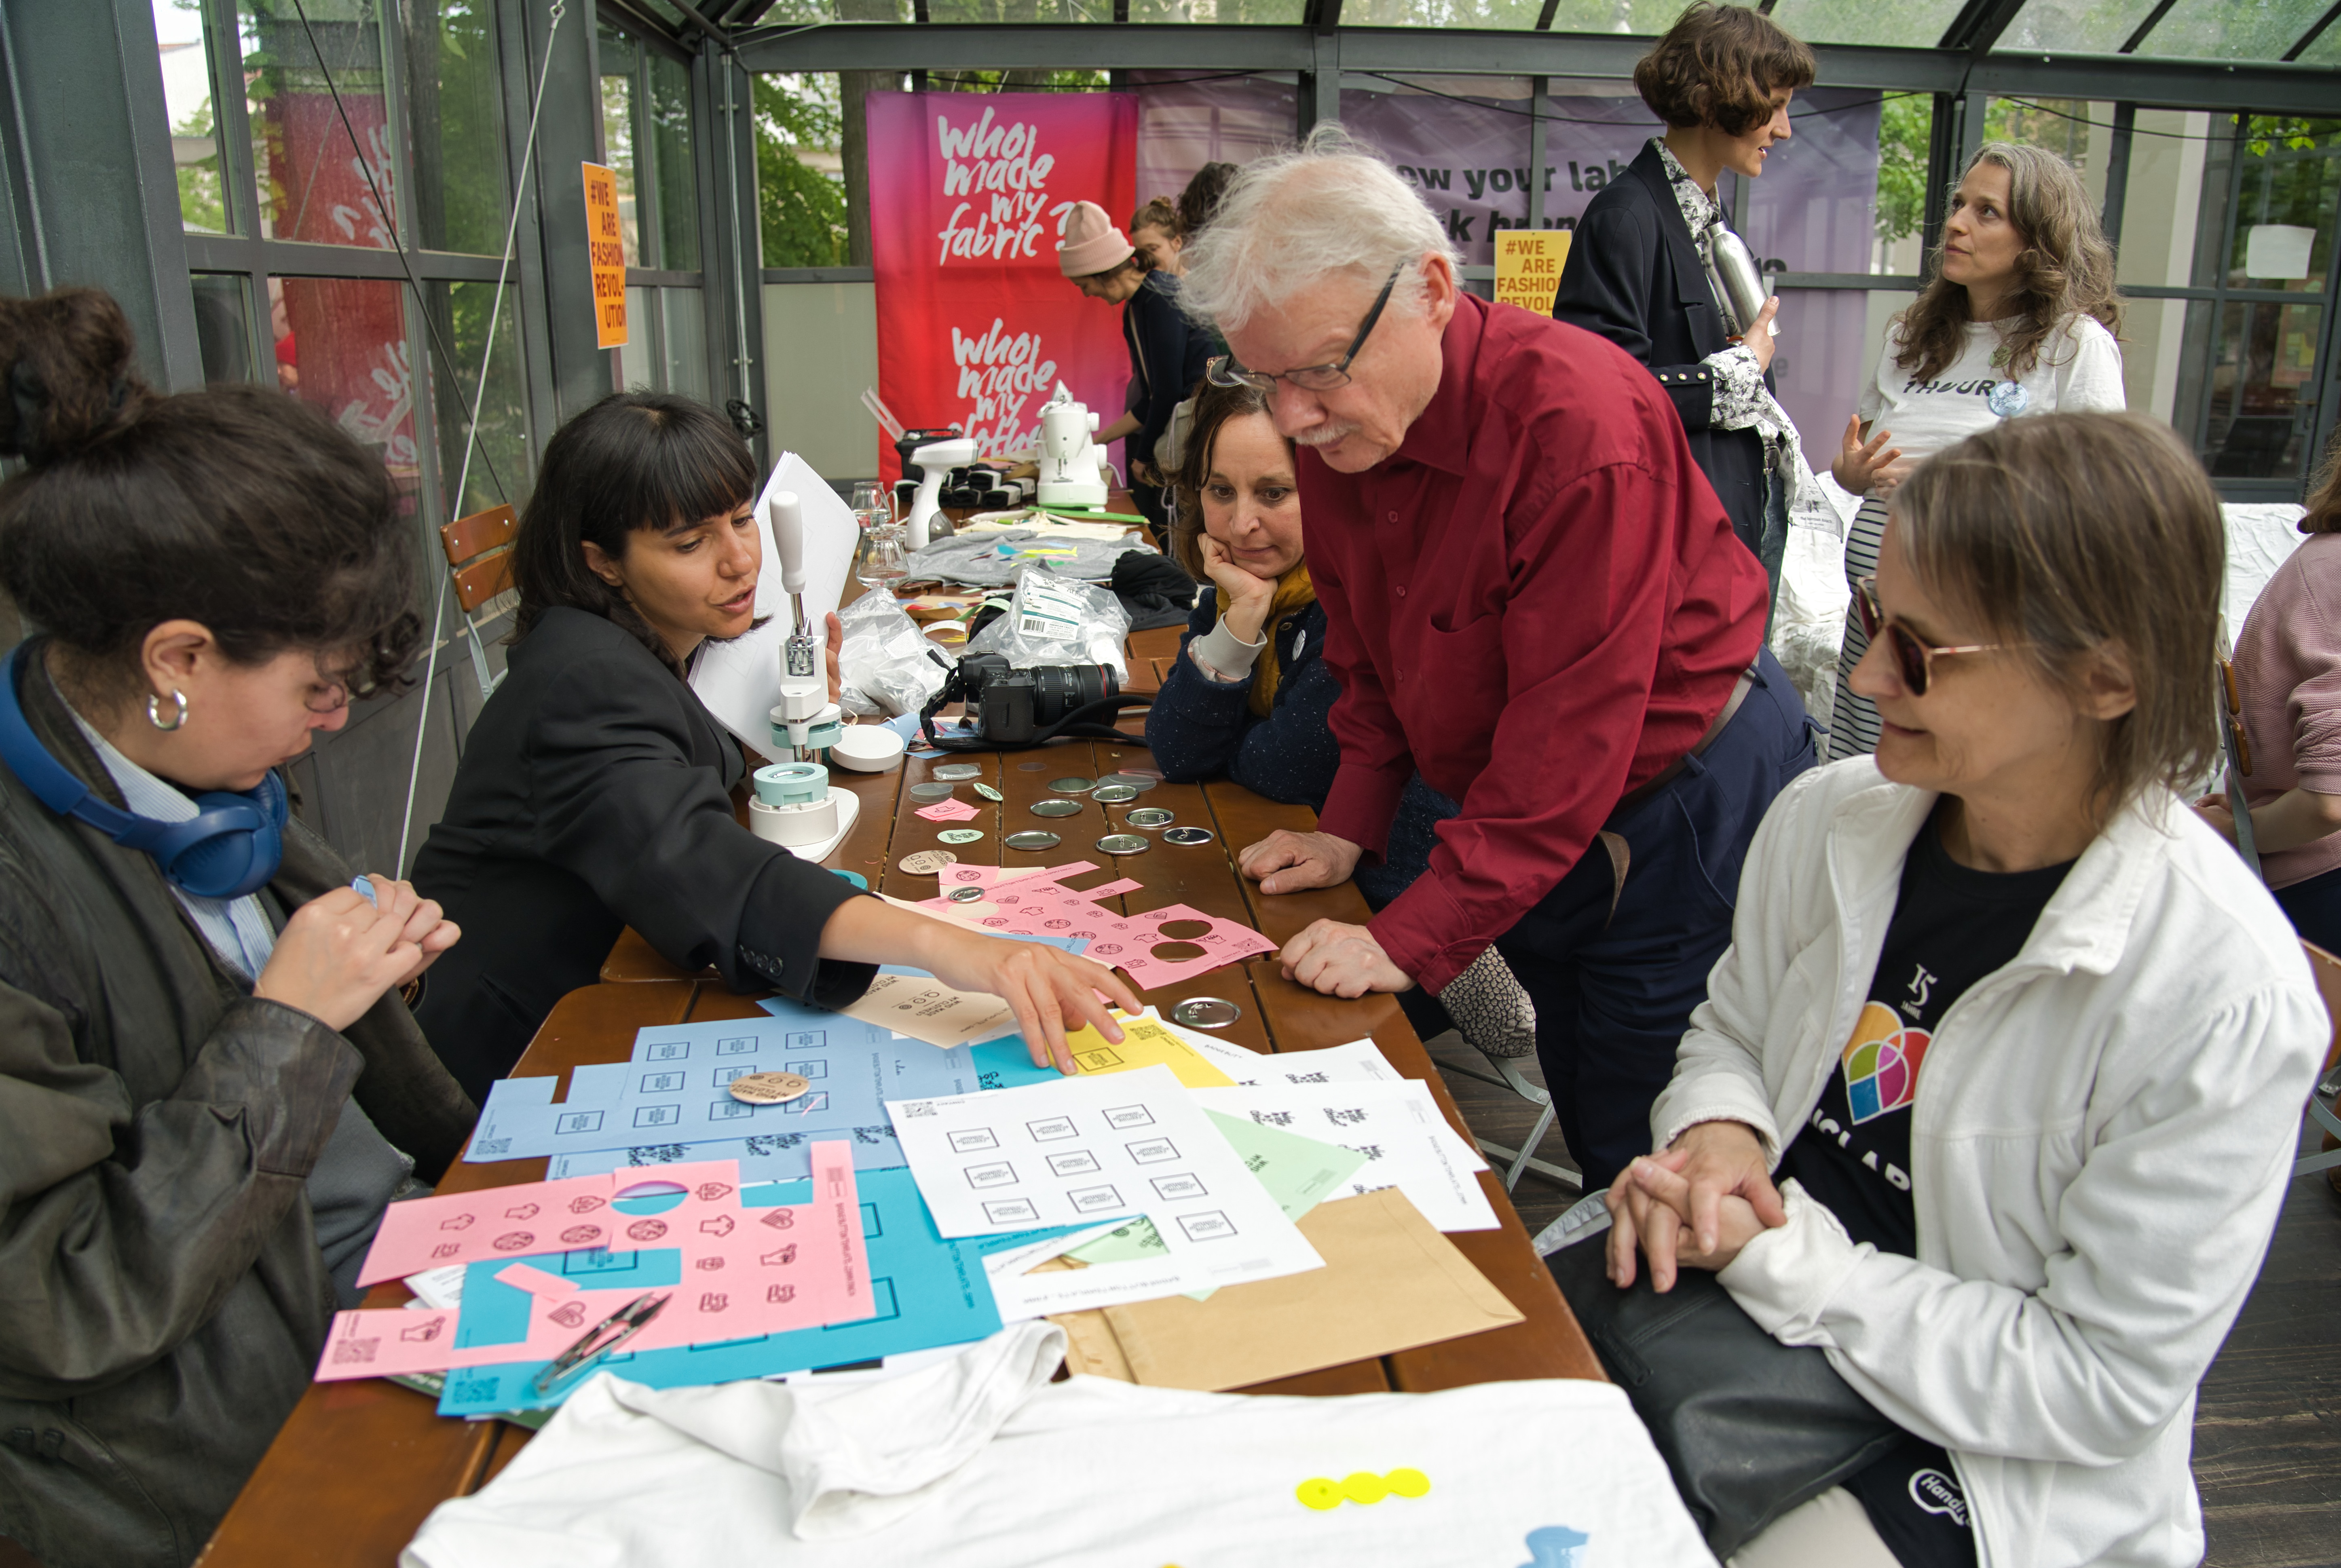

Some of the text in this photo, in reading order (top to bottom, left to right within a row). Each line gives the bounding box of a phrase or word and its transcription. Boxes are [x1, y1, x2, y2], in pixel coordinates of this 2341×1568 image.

[938, 106, 1026, 160] who
[944, 125, 1055, 196] made
[591, 180, 610, 207] #WE
[1396, 160, 1629, 200] ow your lab
[602, 212, 617, 236] ARE
[991, 190, 1048, 231] my
[591, 241, 625, 267] FASHION
[1505, 240, 1544, 255] #WE
[1522, 259, 1555, 274] ARE
[1497, 278, 1561, 292] FASHIO
[604, 304, 627, 329] UTION
[952, 318, 1031, 367] who
[958, 334, 1057, 399] made
[976, 393, 1028, 428] my
[1900, 1000, 1922, 1021] JAHRE
[1921, 1476, 1968, 1520] Hand
